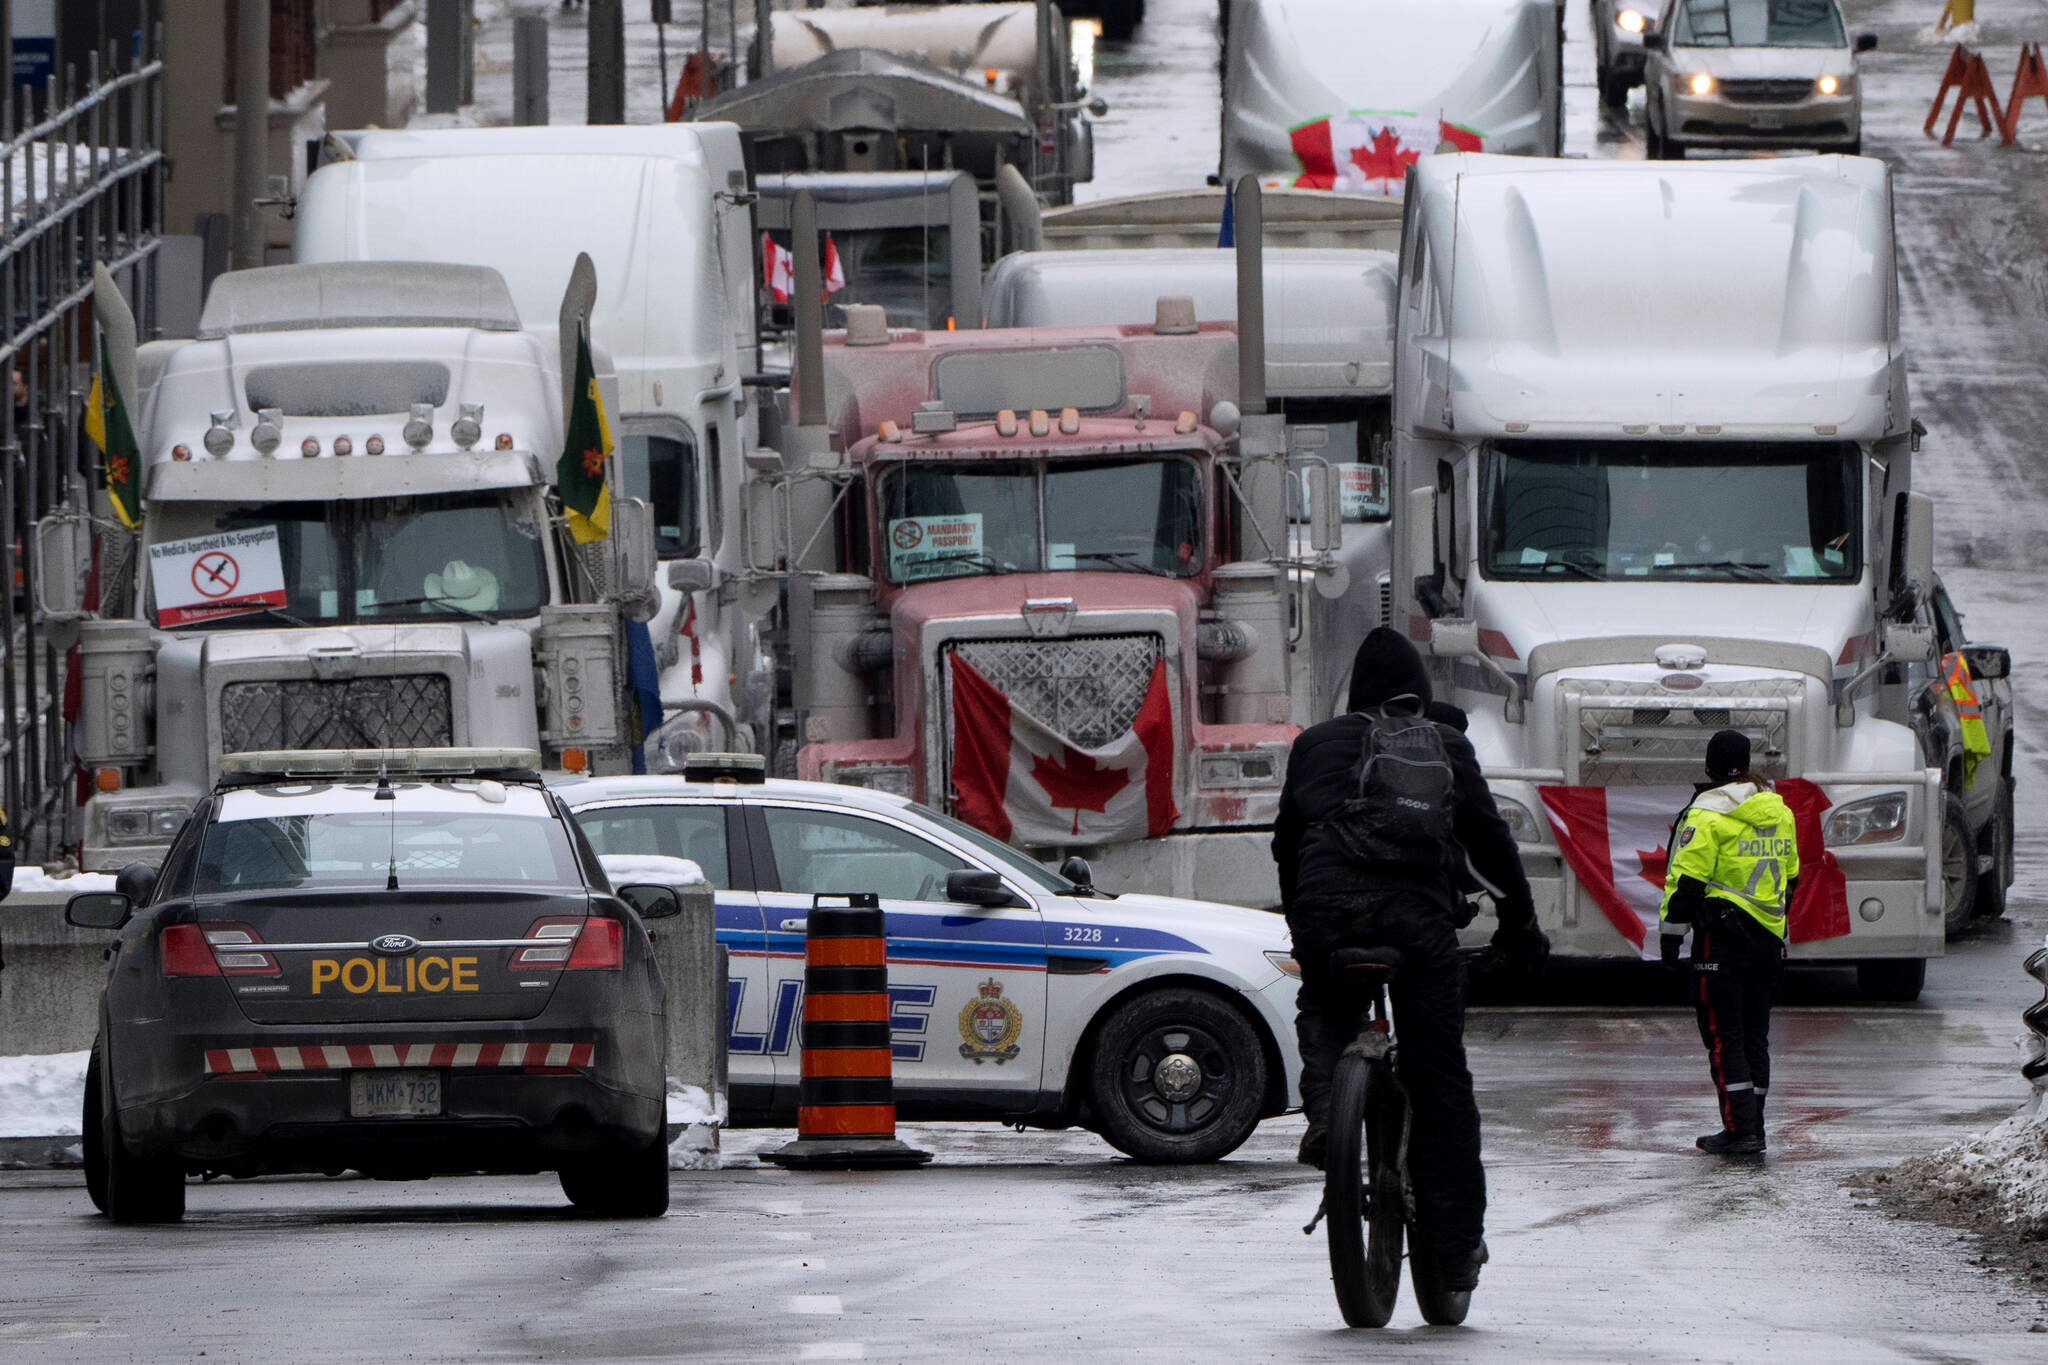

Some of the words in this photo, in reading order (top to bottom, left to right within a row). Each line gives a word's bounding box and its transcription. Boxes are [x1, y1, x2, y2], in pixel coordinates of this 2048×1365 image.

[927, 523, 976, 535] MANDATORY
[151, 547, 160, 558] No
[162, 542, 187, 557] Medical
[188, 536, 219, 554] Apartheid
[226, 534, 236, 546] No
[237, 530, 276, 547] Segregation
[932, 535, 972, 548] PASSPORT
[1737, 838, 1791, 857] POLICE
[382, 936, 407, 948] Ford
[1063, 927, 1102, 943] 3228
[311, 957, 479, 995] POLICE
[406, 1081, 437, 1105] 732
